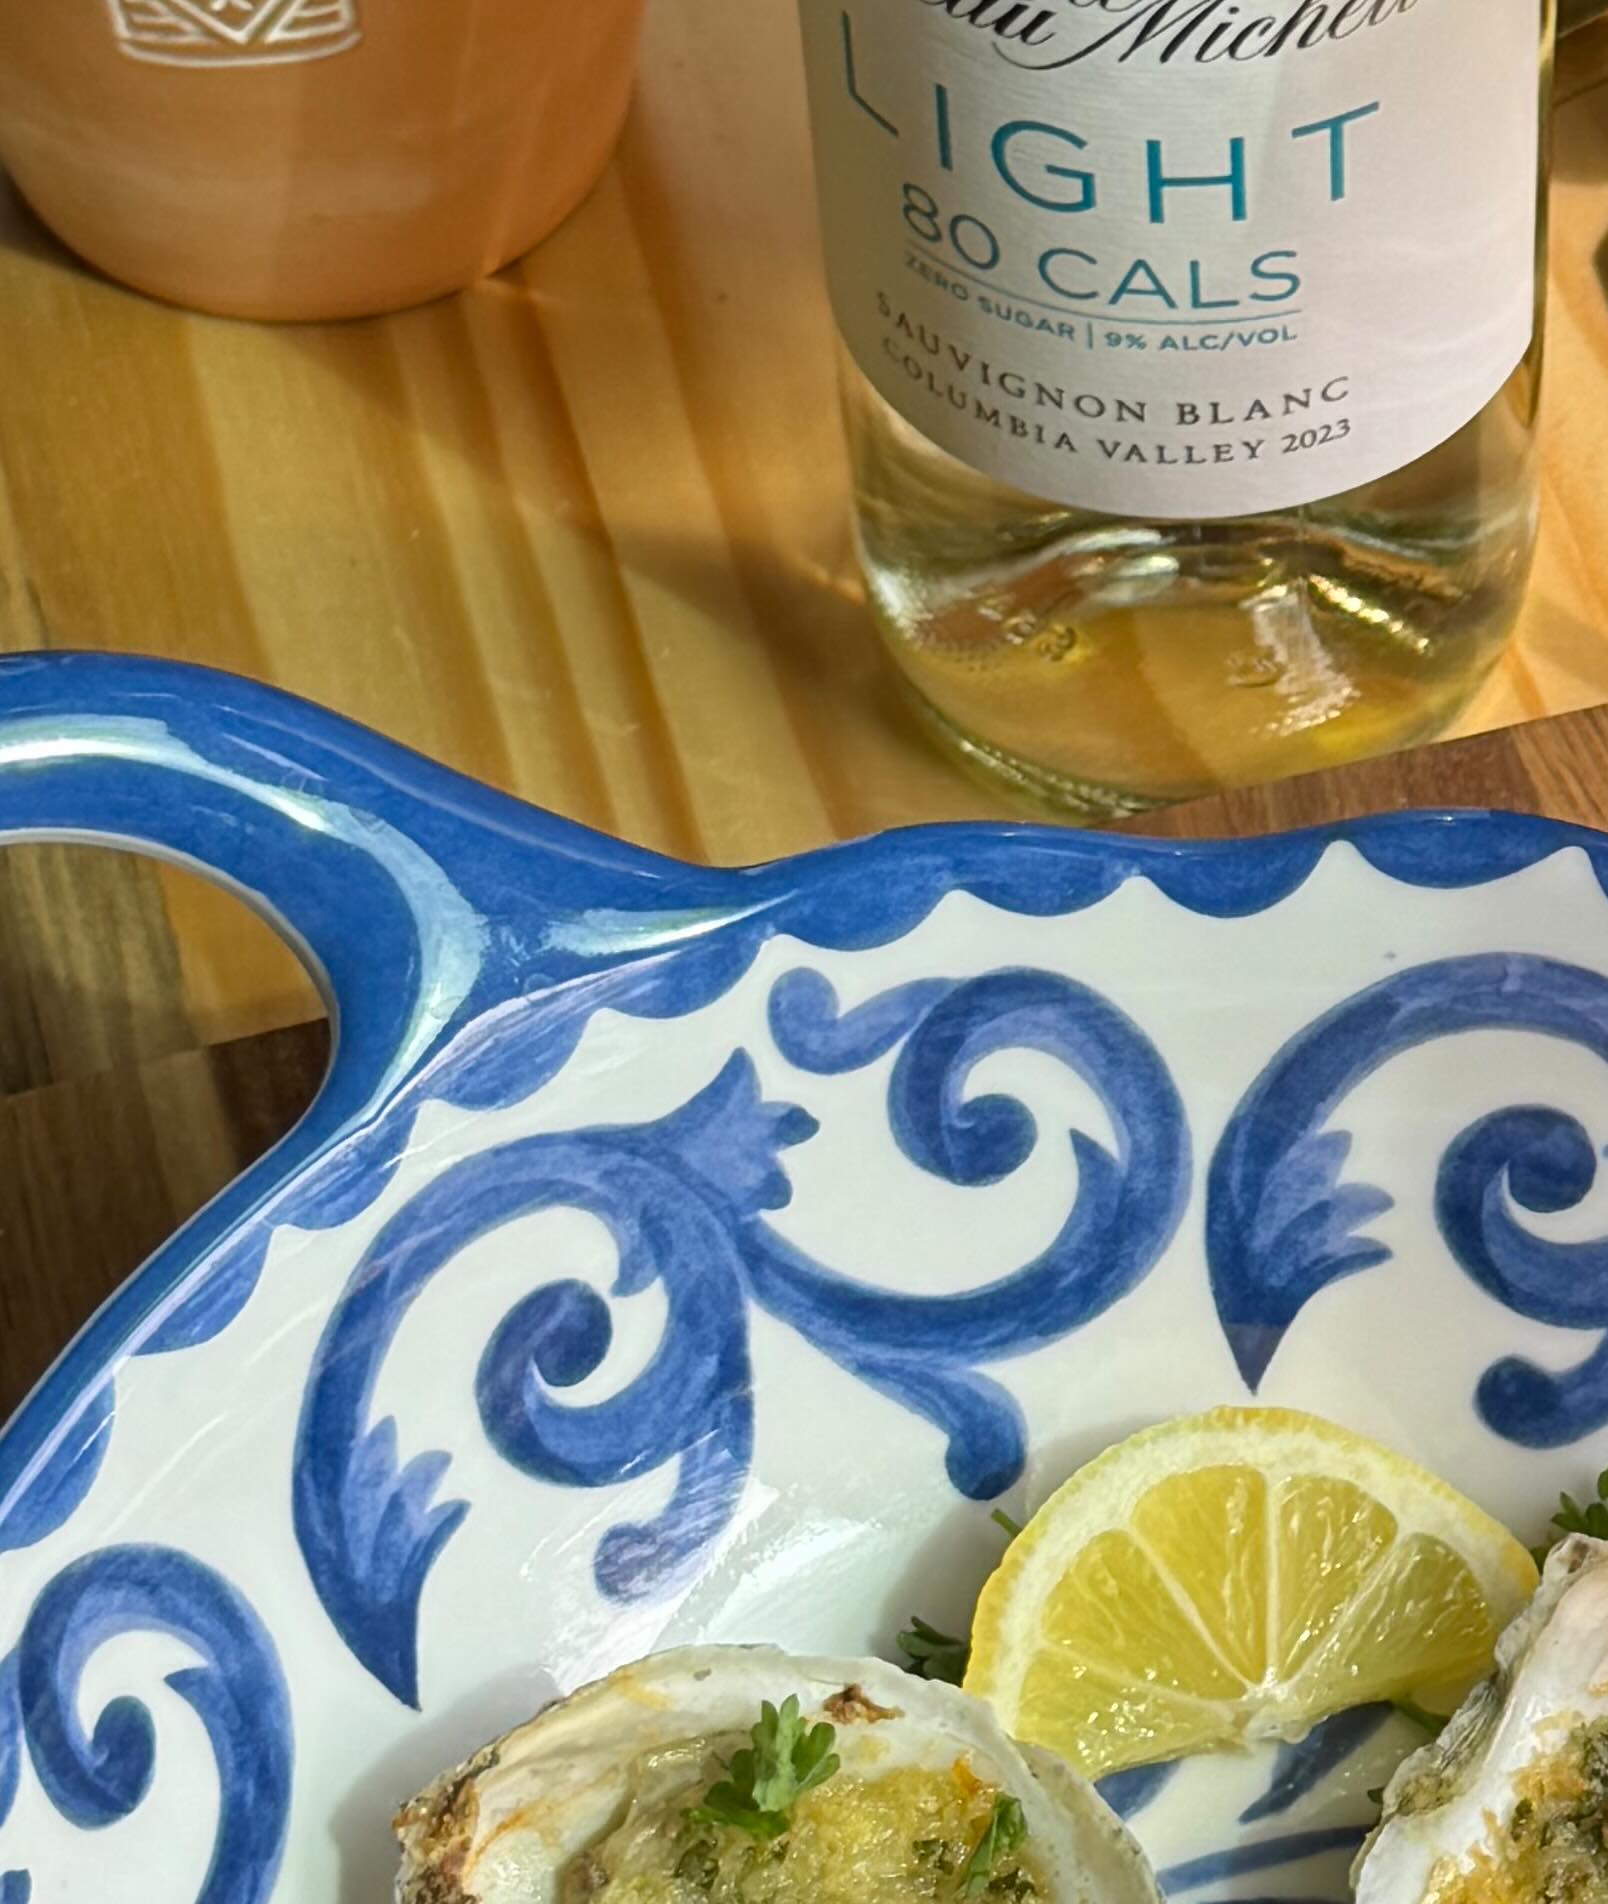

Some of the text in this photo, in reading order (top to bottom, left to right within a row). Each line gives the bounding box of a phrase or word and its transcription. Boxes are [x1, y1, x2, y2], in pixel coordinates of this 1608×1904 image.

[841, 10, 1380, 224] LIGHT
[901, 181, 1301, 310] 80 CALS
[904, 251, 1298, 352] ZERO SUGAR 9% ALC/VOL
[876, 290, 1350, 426] SAUVIGNON BLANC
[881, 336, 1352, 466] COLUMBIA VALLEY 2023
